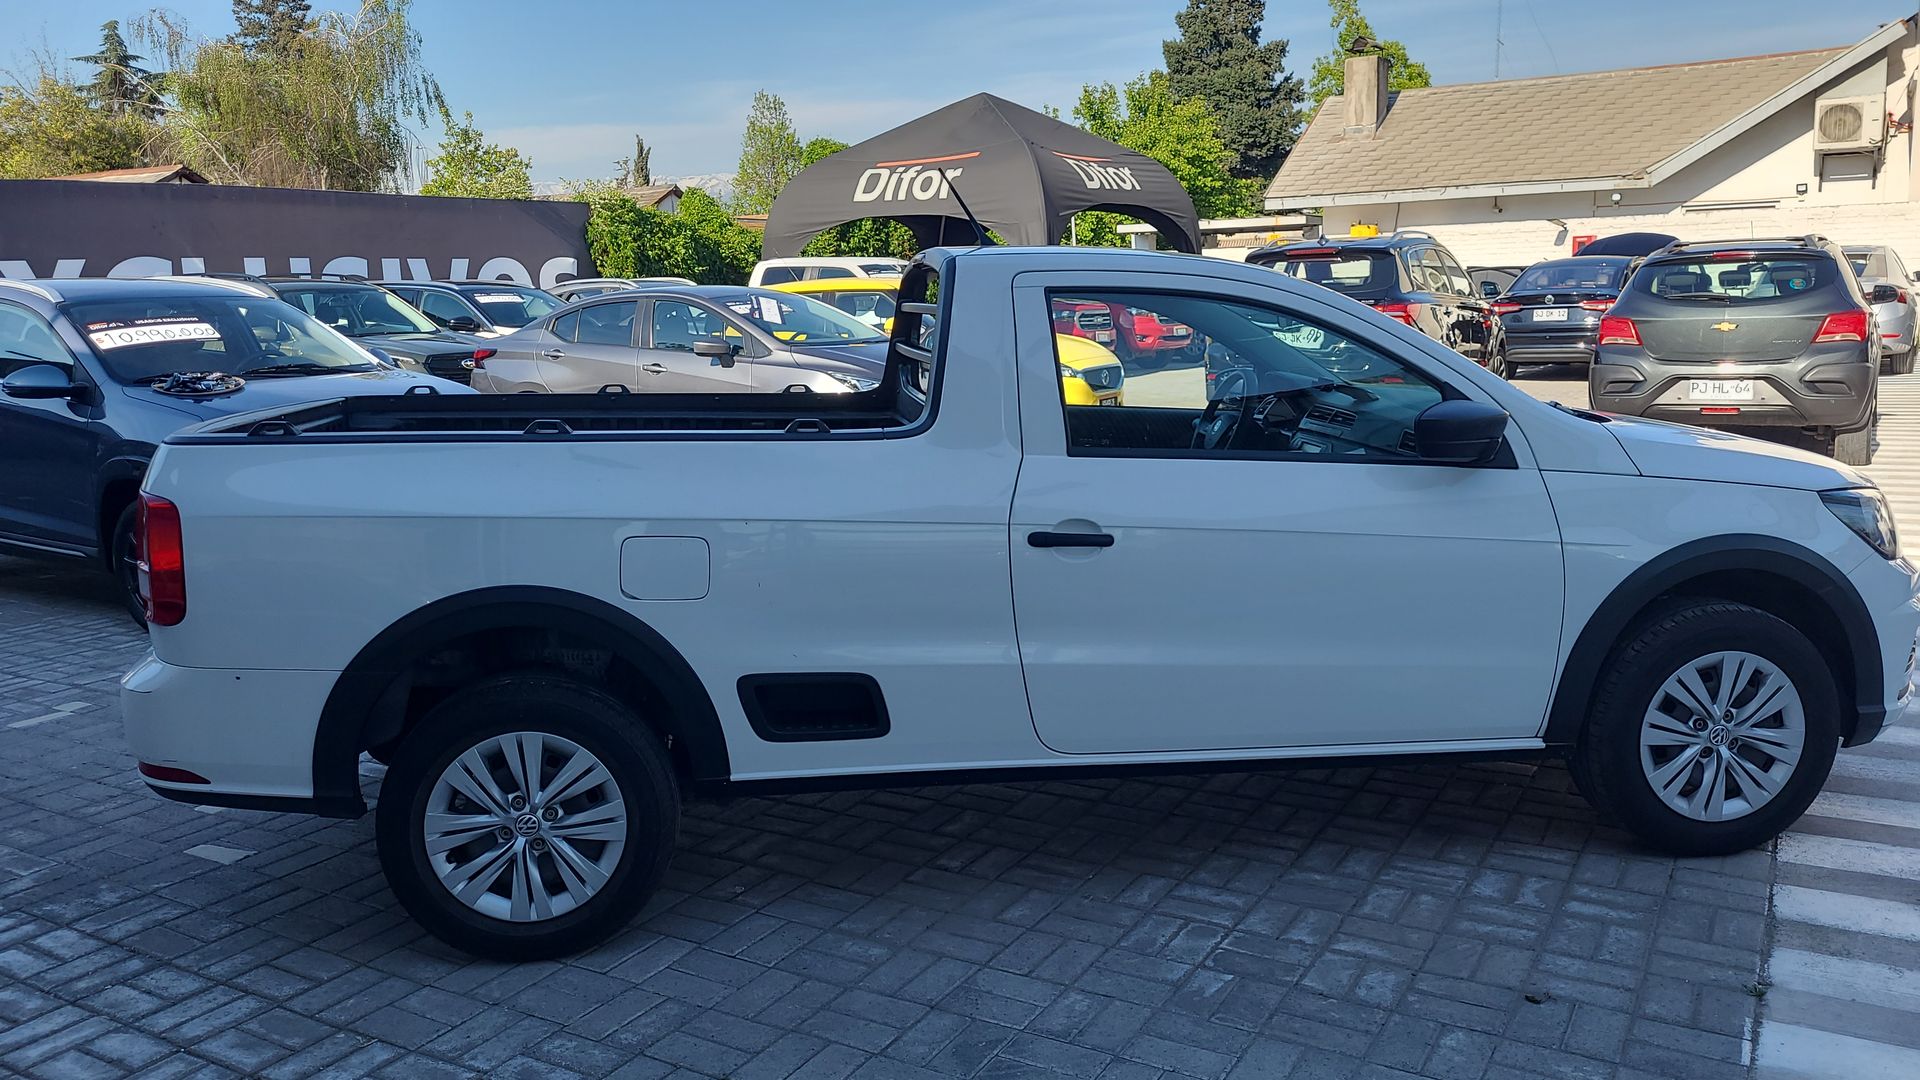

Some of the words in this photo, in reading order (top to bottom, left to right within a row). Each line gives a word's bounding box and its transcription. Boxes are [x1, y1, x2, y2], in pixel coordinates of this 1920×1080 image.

[853, 165, 964, 202] Difor
[1062, 157, 1142, 191] Difor
[1691, 382, 1708, 394] PJ
[1712, 382, 1729, 394] HL
[1735, 383, 1750, 394] 64
